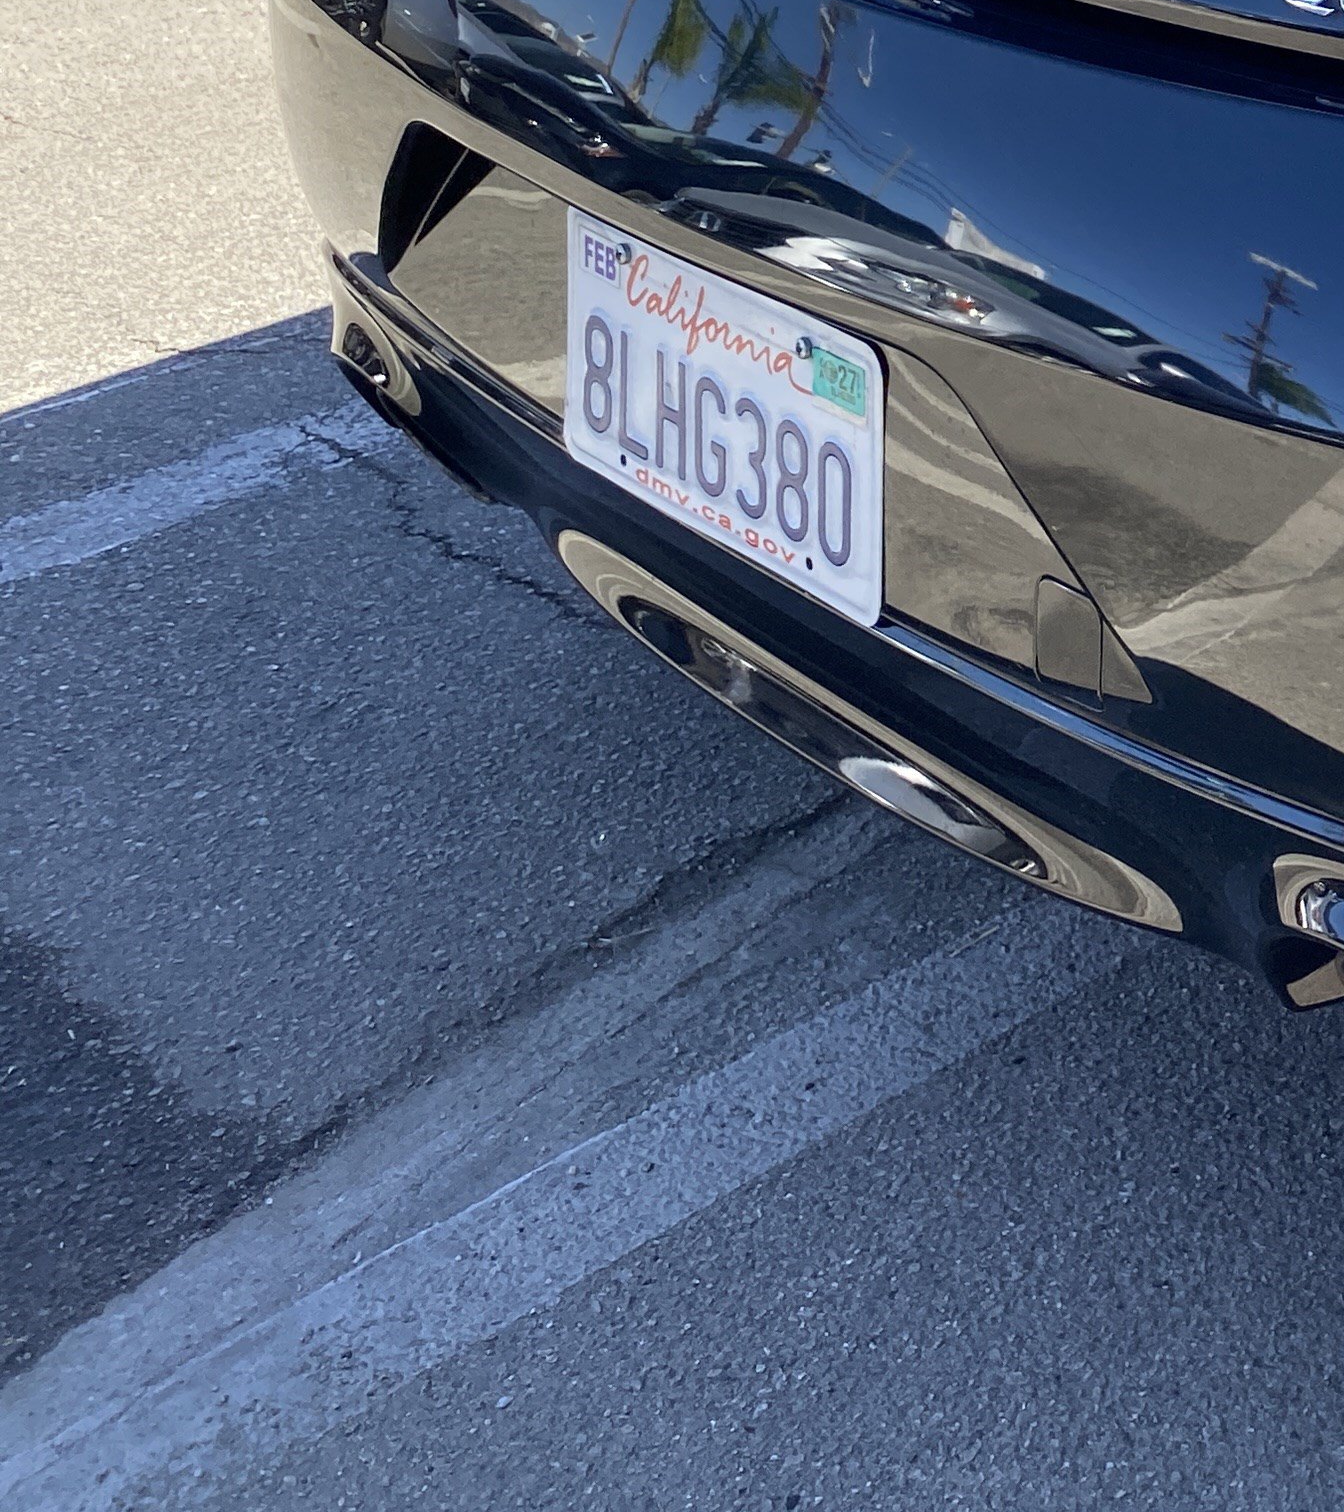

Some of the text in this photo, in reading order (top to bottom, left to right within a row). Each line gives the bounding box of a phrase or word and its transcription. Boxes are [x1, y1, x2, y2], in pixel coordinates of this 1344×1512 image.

[584, 234, 616, 281] FEB
[626, 254, 813, 396] California
[838, 364, 858, 394] 27
[583, 314, 852, 567] 8LHG380
[635, 467, 796, 564] dmv.ca.gov
